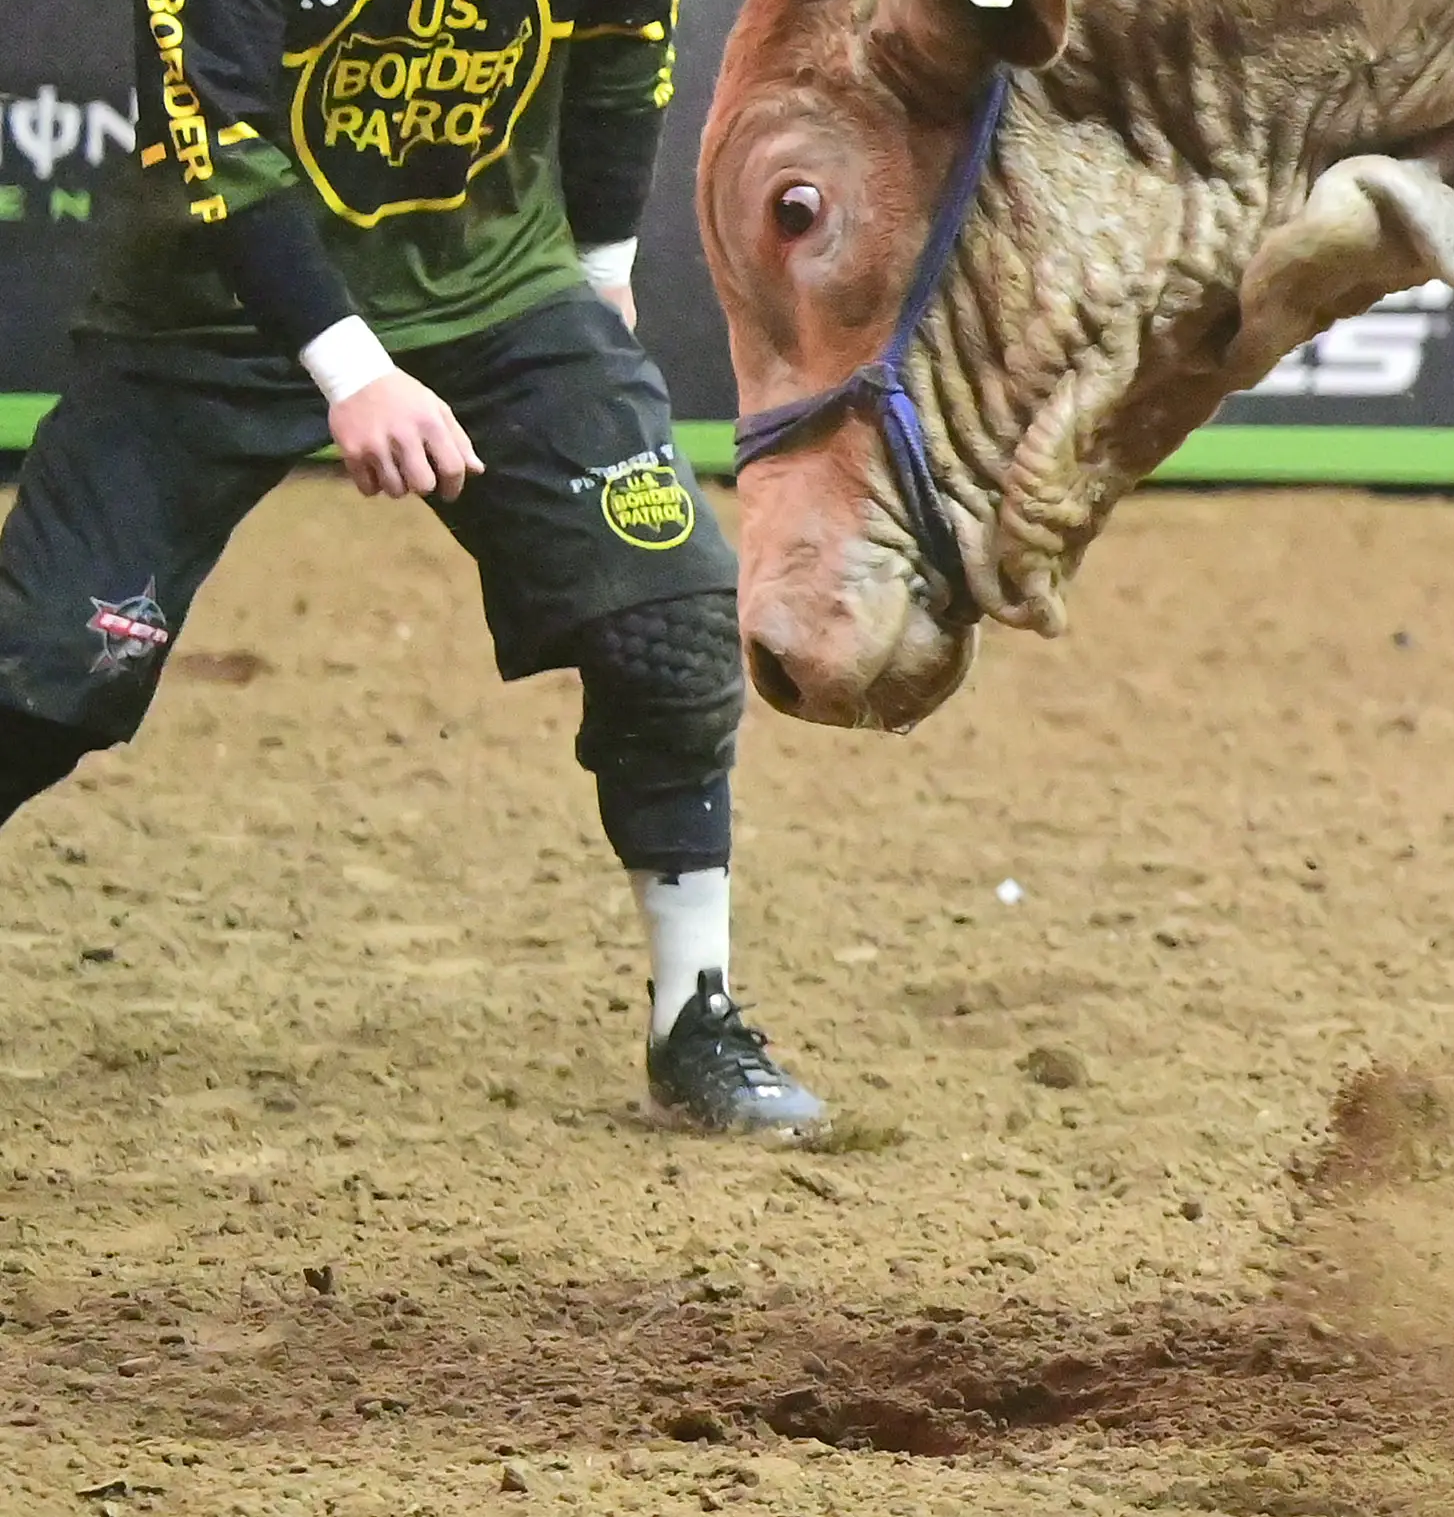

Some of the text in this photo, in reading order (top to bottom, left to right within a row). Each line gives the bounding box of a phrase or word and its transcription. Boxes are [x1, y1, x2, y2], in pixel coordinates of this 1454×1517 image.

[333, 47, 523, 101] BORDER
[324, 98, 495, 156] PARO
[614, 486, 683, 512] BORDER
[619, 504, 686, 529] PATROL
